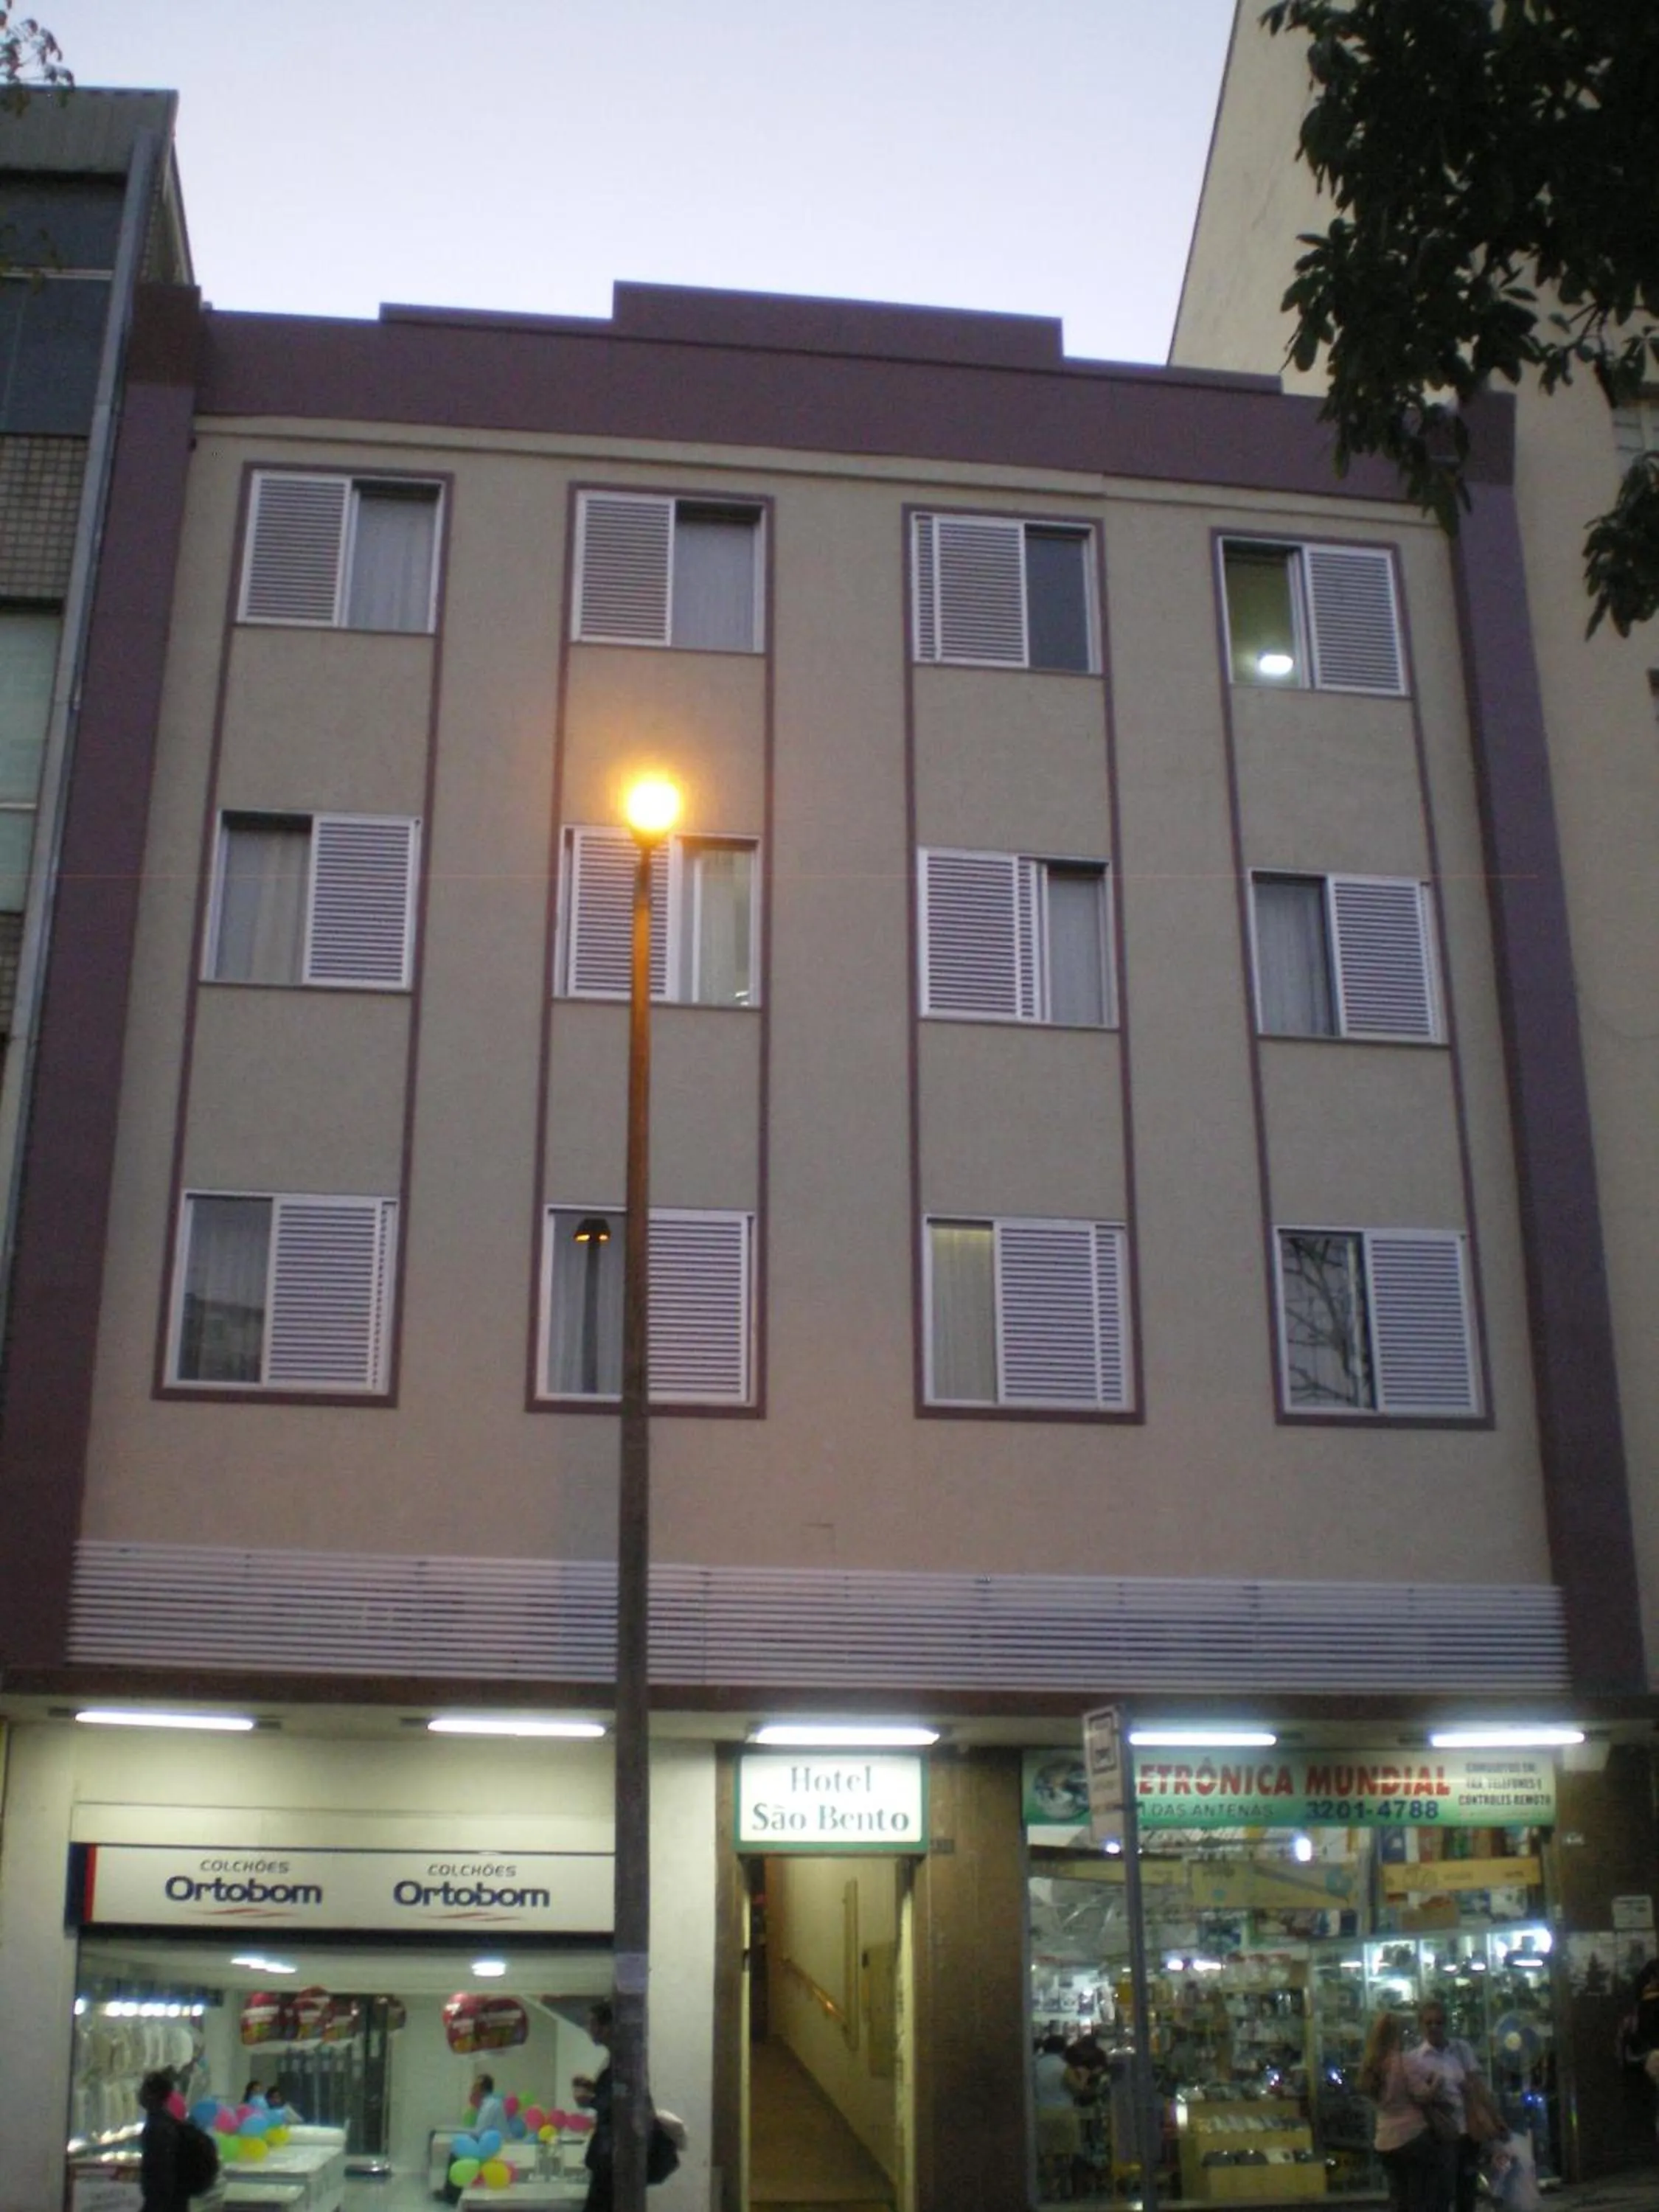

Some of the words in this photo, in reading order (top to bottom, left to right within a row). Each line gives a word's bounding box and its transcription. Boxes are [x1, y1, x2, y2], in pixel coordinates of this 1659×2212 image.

[790, 1765, 872, 1793] Hotel
[1304, 1765, 1450, 1796] MUNDIAL
[751, 1802, 807, 1831] São
[818, 1804, 909, 1832] Bento
[1151, 1801, 1188, 1817] DAS
[1192, 1801, 1275, 1818] ANTENAS
[1305, 1800, 1439, 1820] 3201-4788
[199, 1859, 290, 1874] COLCHÕES
[428, 1863, 517, 1878] COLCHÕES
[164, 1875, 322, 1905] Ortobom
[393, 1879, 551, 1909] Ortobom
